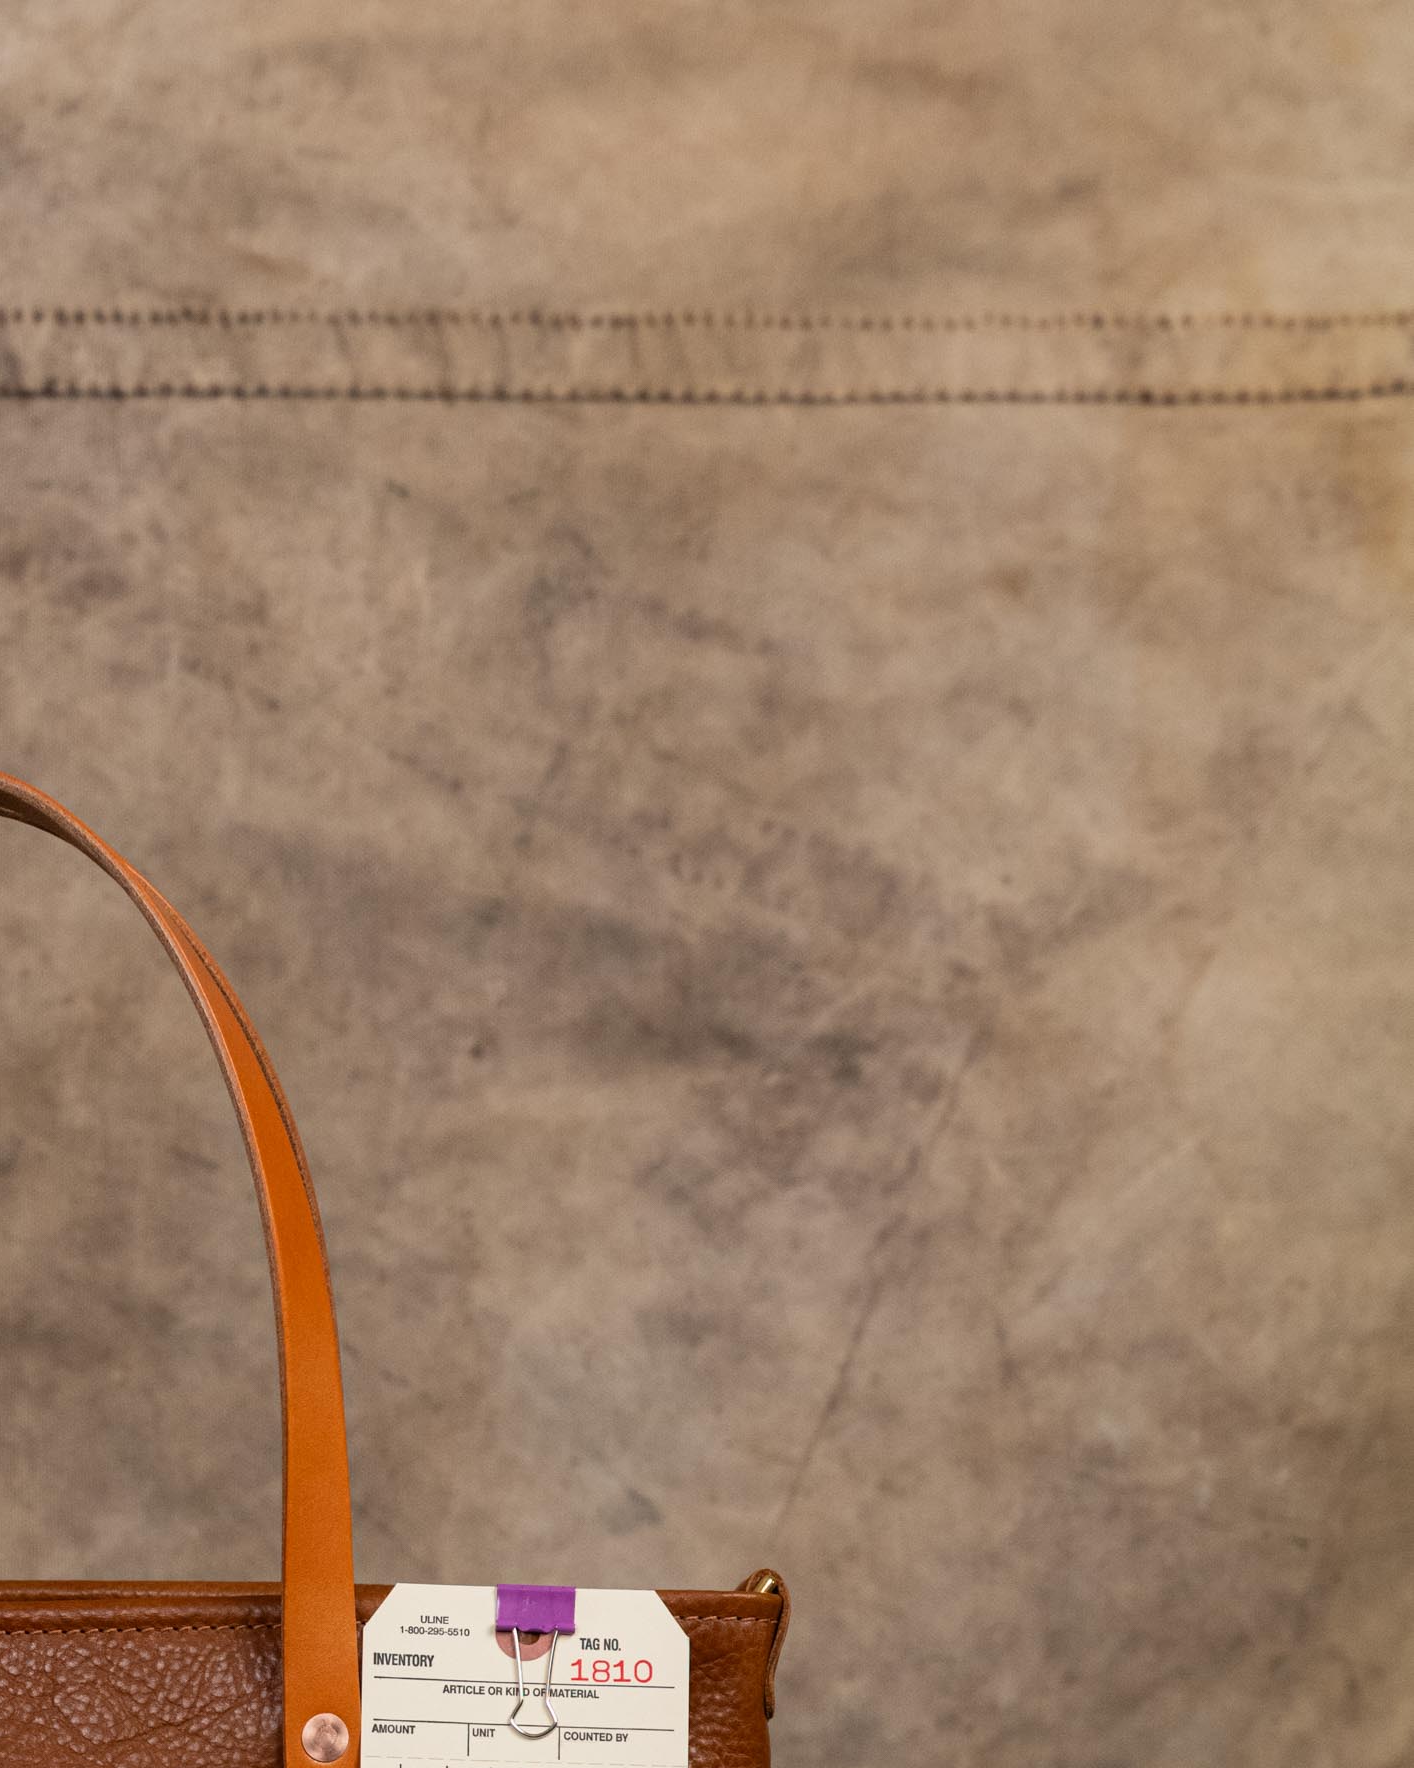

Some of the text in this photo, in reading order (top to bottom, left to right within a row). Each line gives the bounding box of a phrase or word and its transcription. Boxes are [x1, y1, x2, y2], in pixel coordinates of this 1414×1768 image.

[420, 1615, 449, 1625] ULINE
[399, 1626, 470, 1637] 1-800-295-5510
[579, 1638, 622, 1651] TAG NO.
[373, 1653, 435, 1668] INVENTORY
[570, 1659, 653, 1684] 1810
[442, 1684, 486, 1696] ARTICLE
[487, 1686, 503, 1696] OR
[532, 1687, 547, 1698] OF
[549, 1688, 600, 1699] MATERIAL
[371, 1724, 416, 1735] AMOUNT
[472, 1728, 496, 1738] UNIT
[563, 1731, 629, 1743] COUNTED BY
